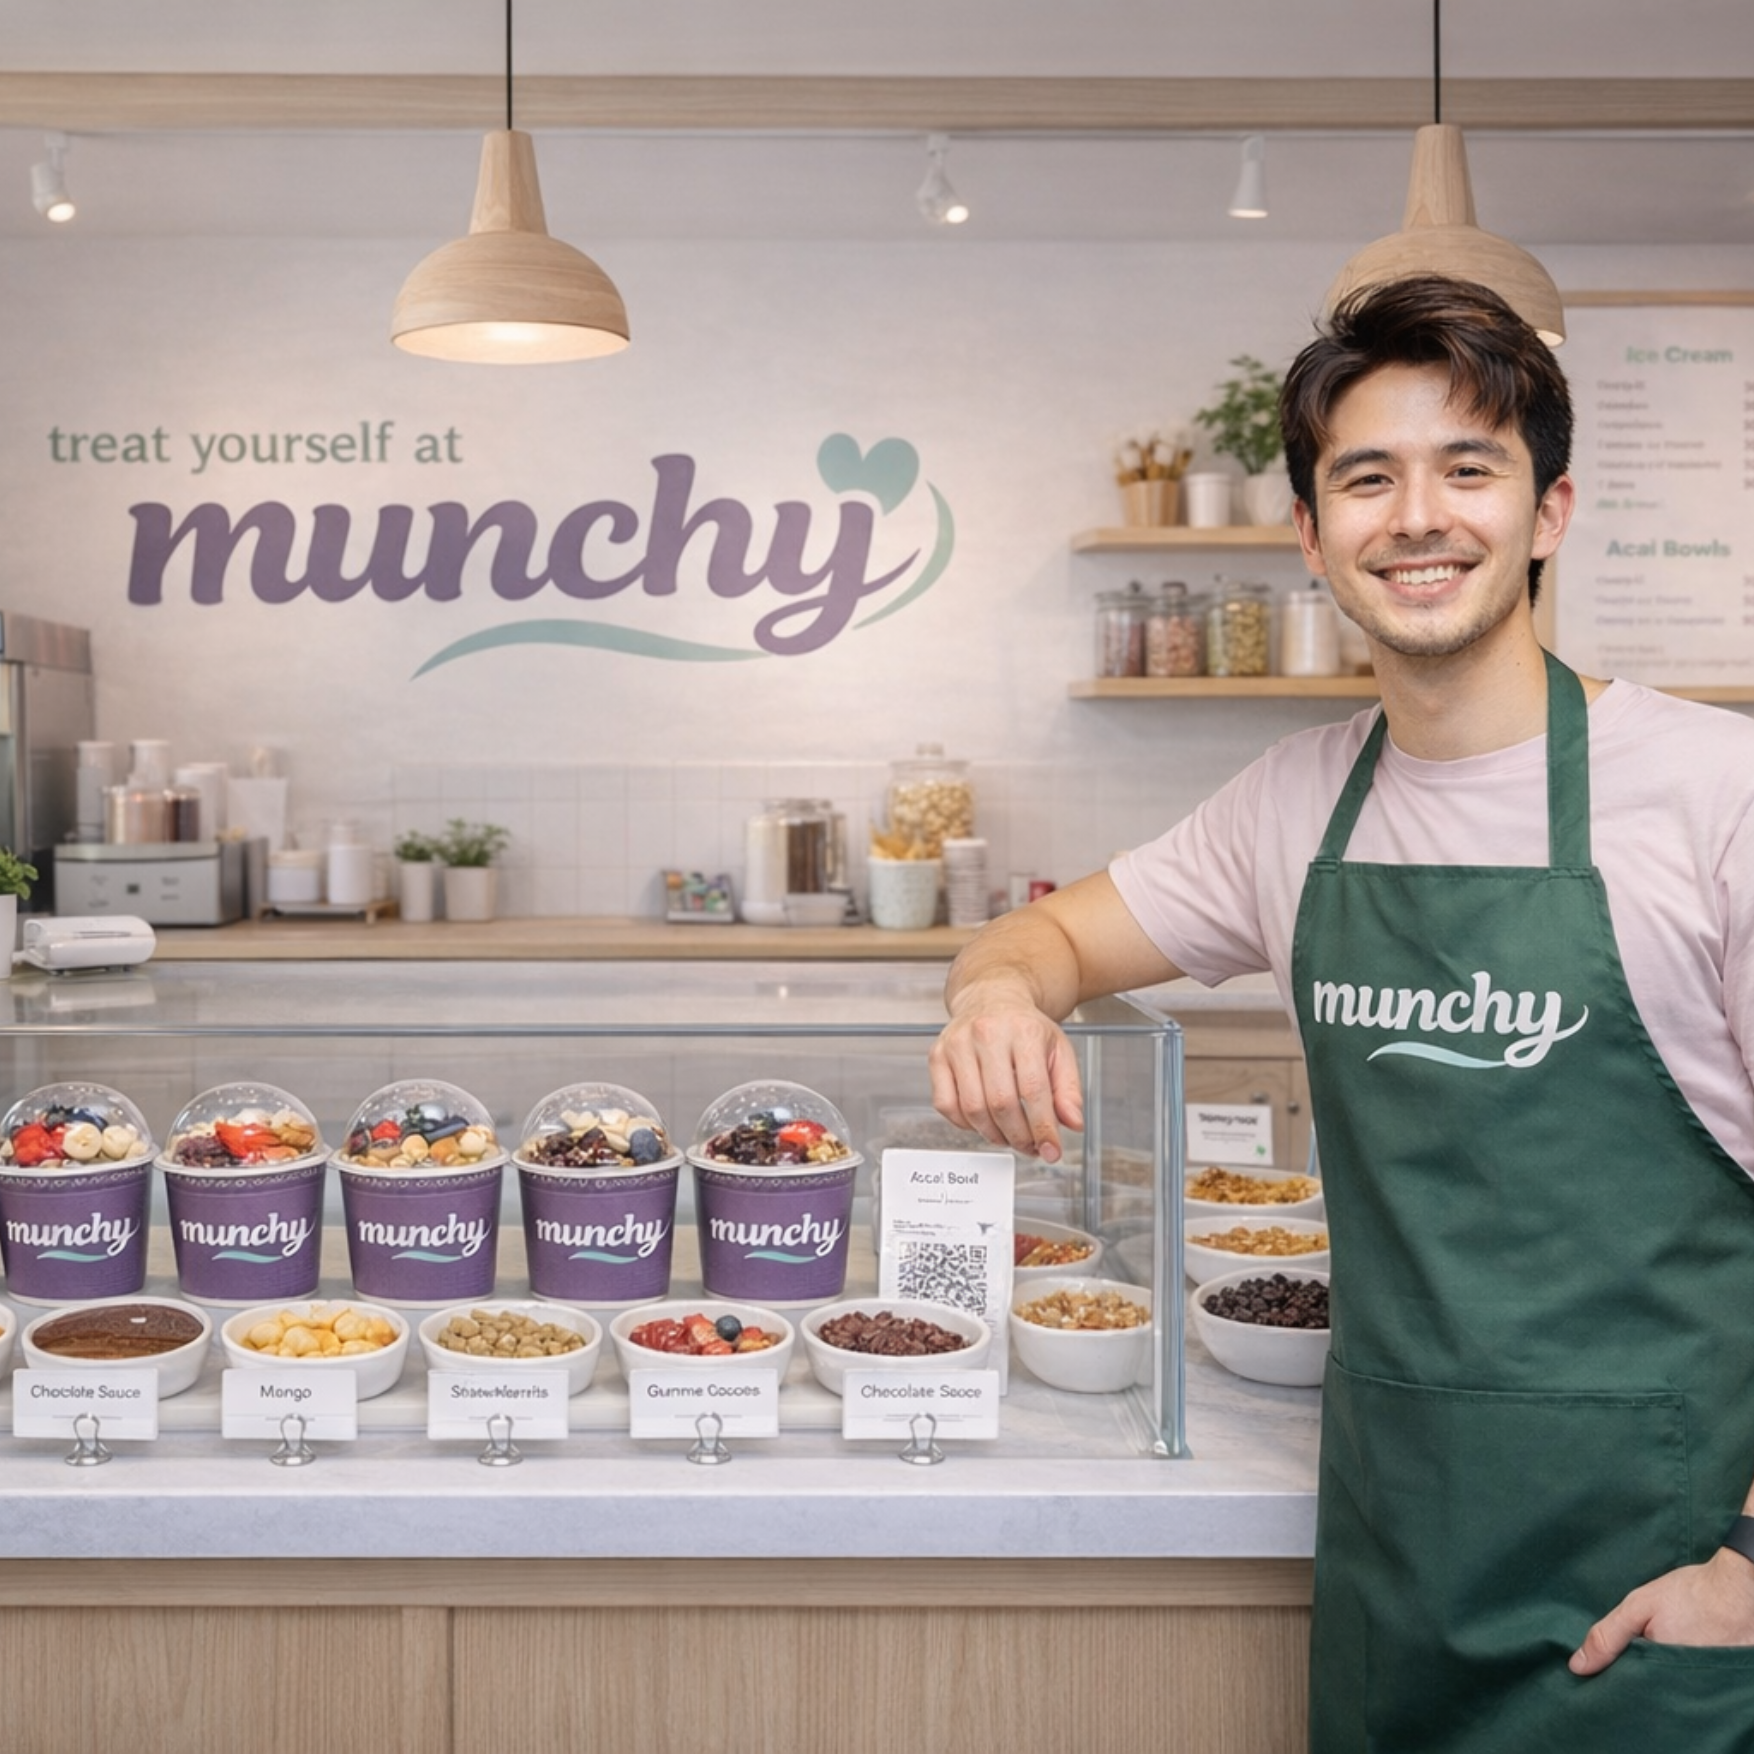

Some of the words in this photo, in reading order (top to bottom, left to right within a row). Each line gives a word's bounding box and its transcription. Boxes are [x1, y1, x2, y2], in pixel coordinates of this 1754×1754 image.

[1626, 347, 1659, 364] Ice
[1664, 346, 1733, 364] Cream
[48, 426, 171, 463] treat
[190, 421, 394, 474] yourself
[414, 426, 463, 463] at
[128, 453, 920, 656] munchy
[1663, 539, 1731, 557] Bowls
[1313, 971, 1589, 1068] munchy
[6, 1212, 140, 1257] munchy
[180, 1212, 316, 1257] munchy
[358, 1213, 491, 1258] munchy
[536, 1213, 671, 1258] munchy
[710, 1212, 849, 1257] munchy
